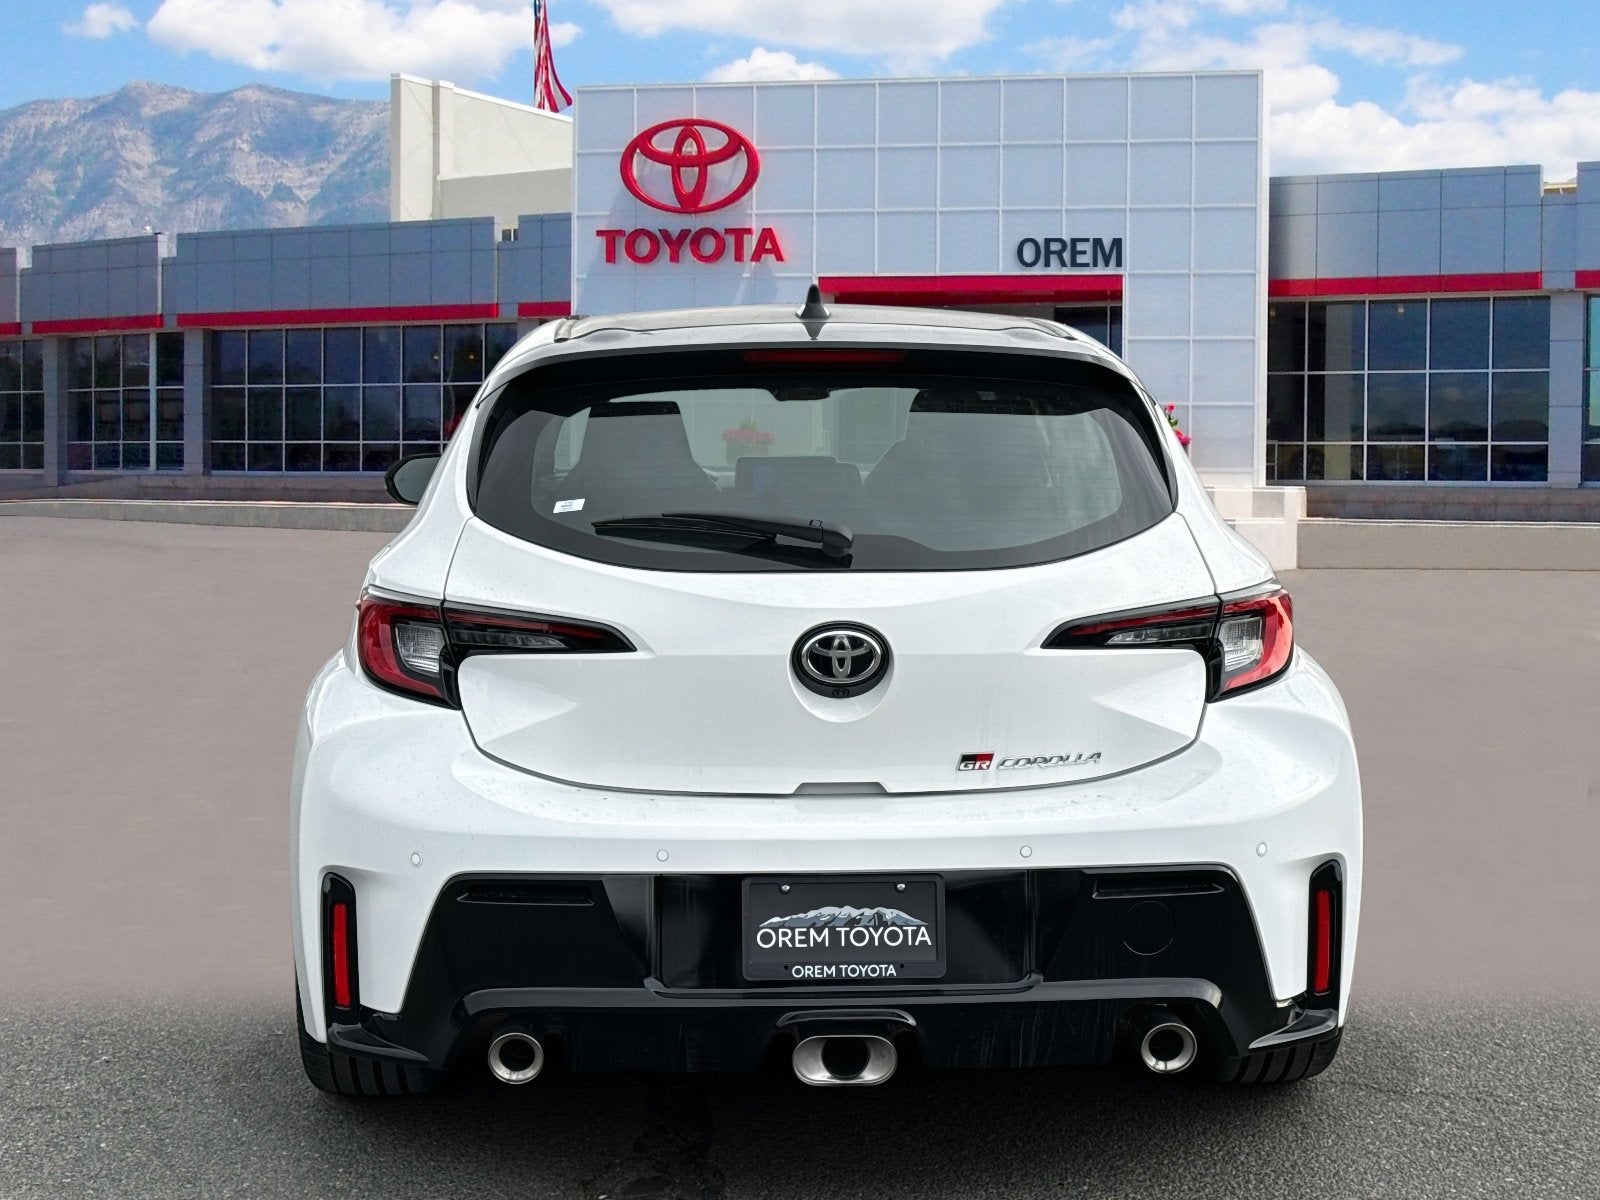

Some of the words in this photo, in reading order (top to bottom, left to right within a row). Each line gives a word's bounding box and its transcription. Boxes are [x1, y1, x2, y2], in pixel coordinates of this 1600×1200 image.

[595, 227, 785, 264] TOYOTA
[1016, 237, 1123, 268] OREM
[958, 758, 991, 771] GR
[997, 752, 1102, 770] COROLLA
[756, 927, 829, 948] OREM
[835, 926, 932, 947] TOYOTA
[791, 965, 836, 978] OREM
[839, 964, 897, 978] TOYOTA
